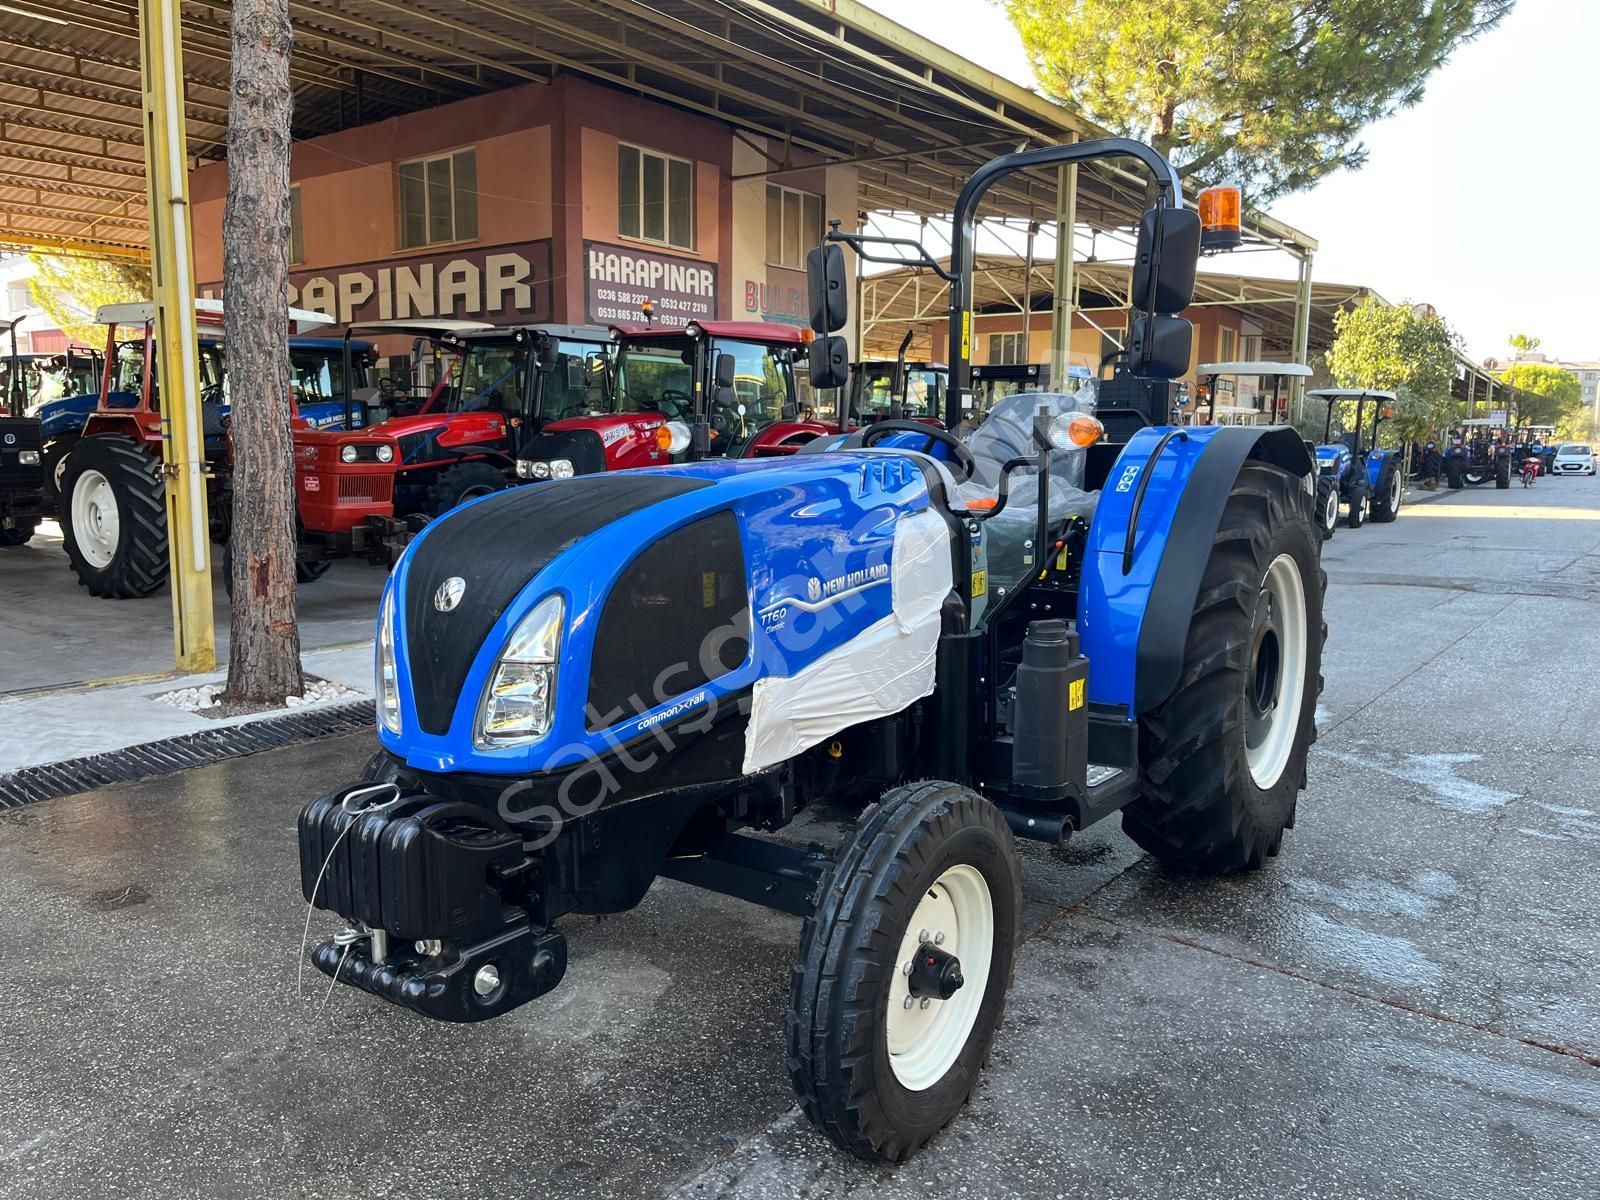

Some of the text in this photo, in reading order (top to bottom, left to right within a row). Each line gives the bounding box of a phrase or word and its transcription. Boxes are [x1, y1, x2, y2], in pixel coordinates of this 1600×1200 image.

[589, 250, 714, 297] KARAPINAR
[203, 253, 532, 326] APINAR
[597, 289, 616, 301] 0236
[617, 291, 631, 304] 588
[660, 298, 678, 310] 0532
[678, 301, 692, 311] 427
[692, 302, 708, 313] 2319
[597, 307, 616, 319] 0533
[660, 314, 678, 326] 0533
[822, 563, 888, 597] NEW HOLLAND
[761, 607, 787, 627] TT60
